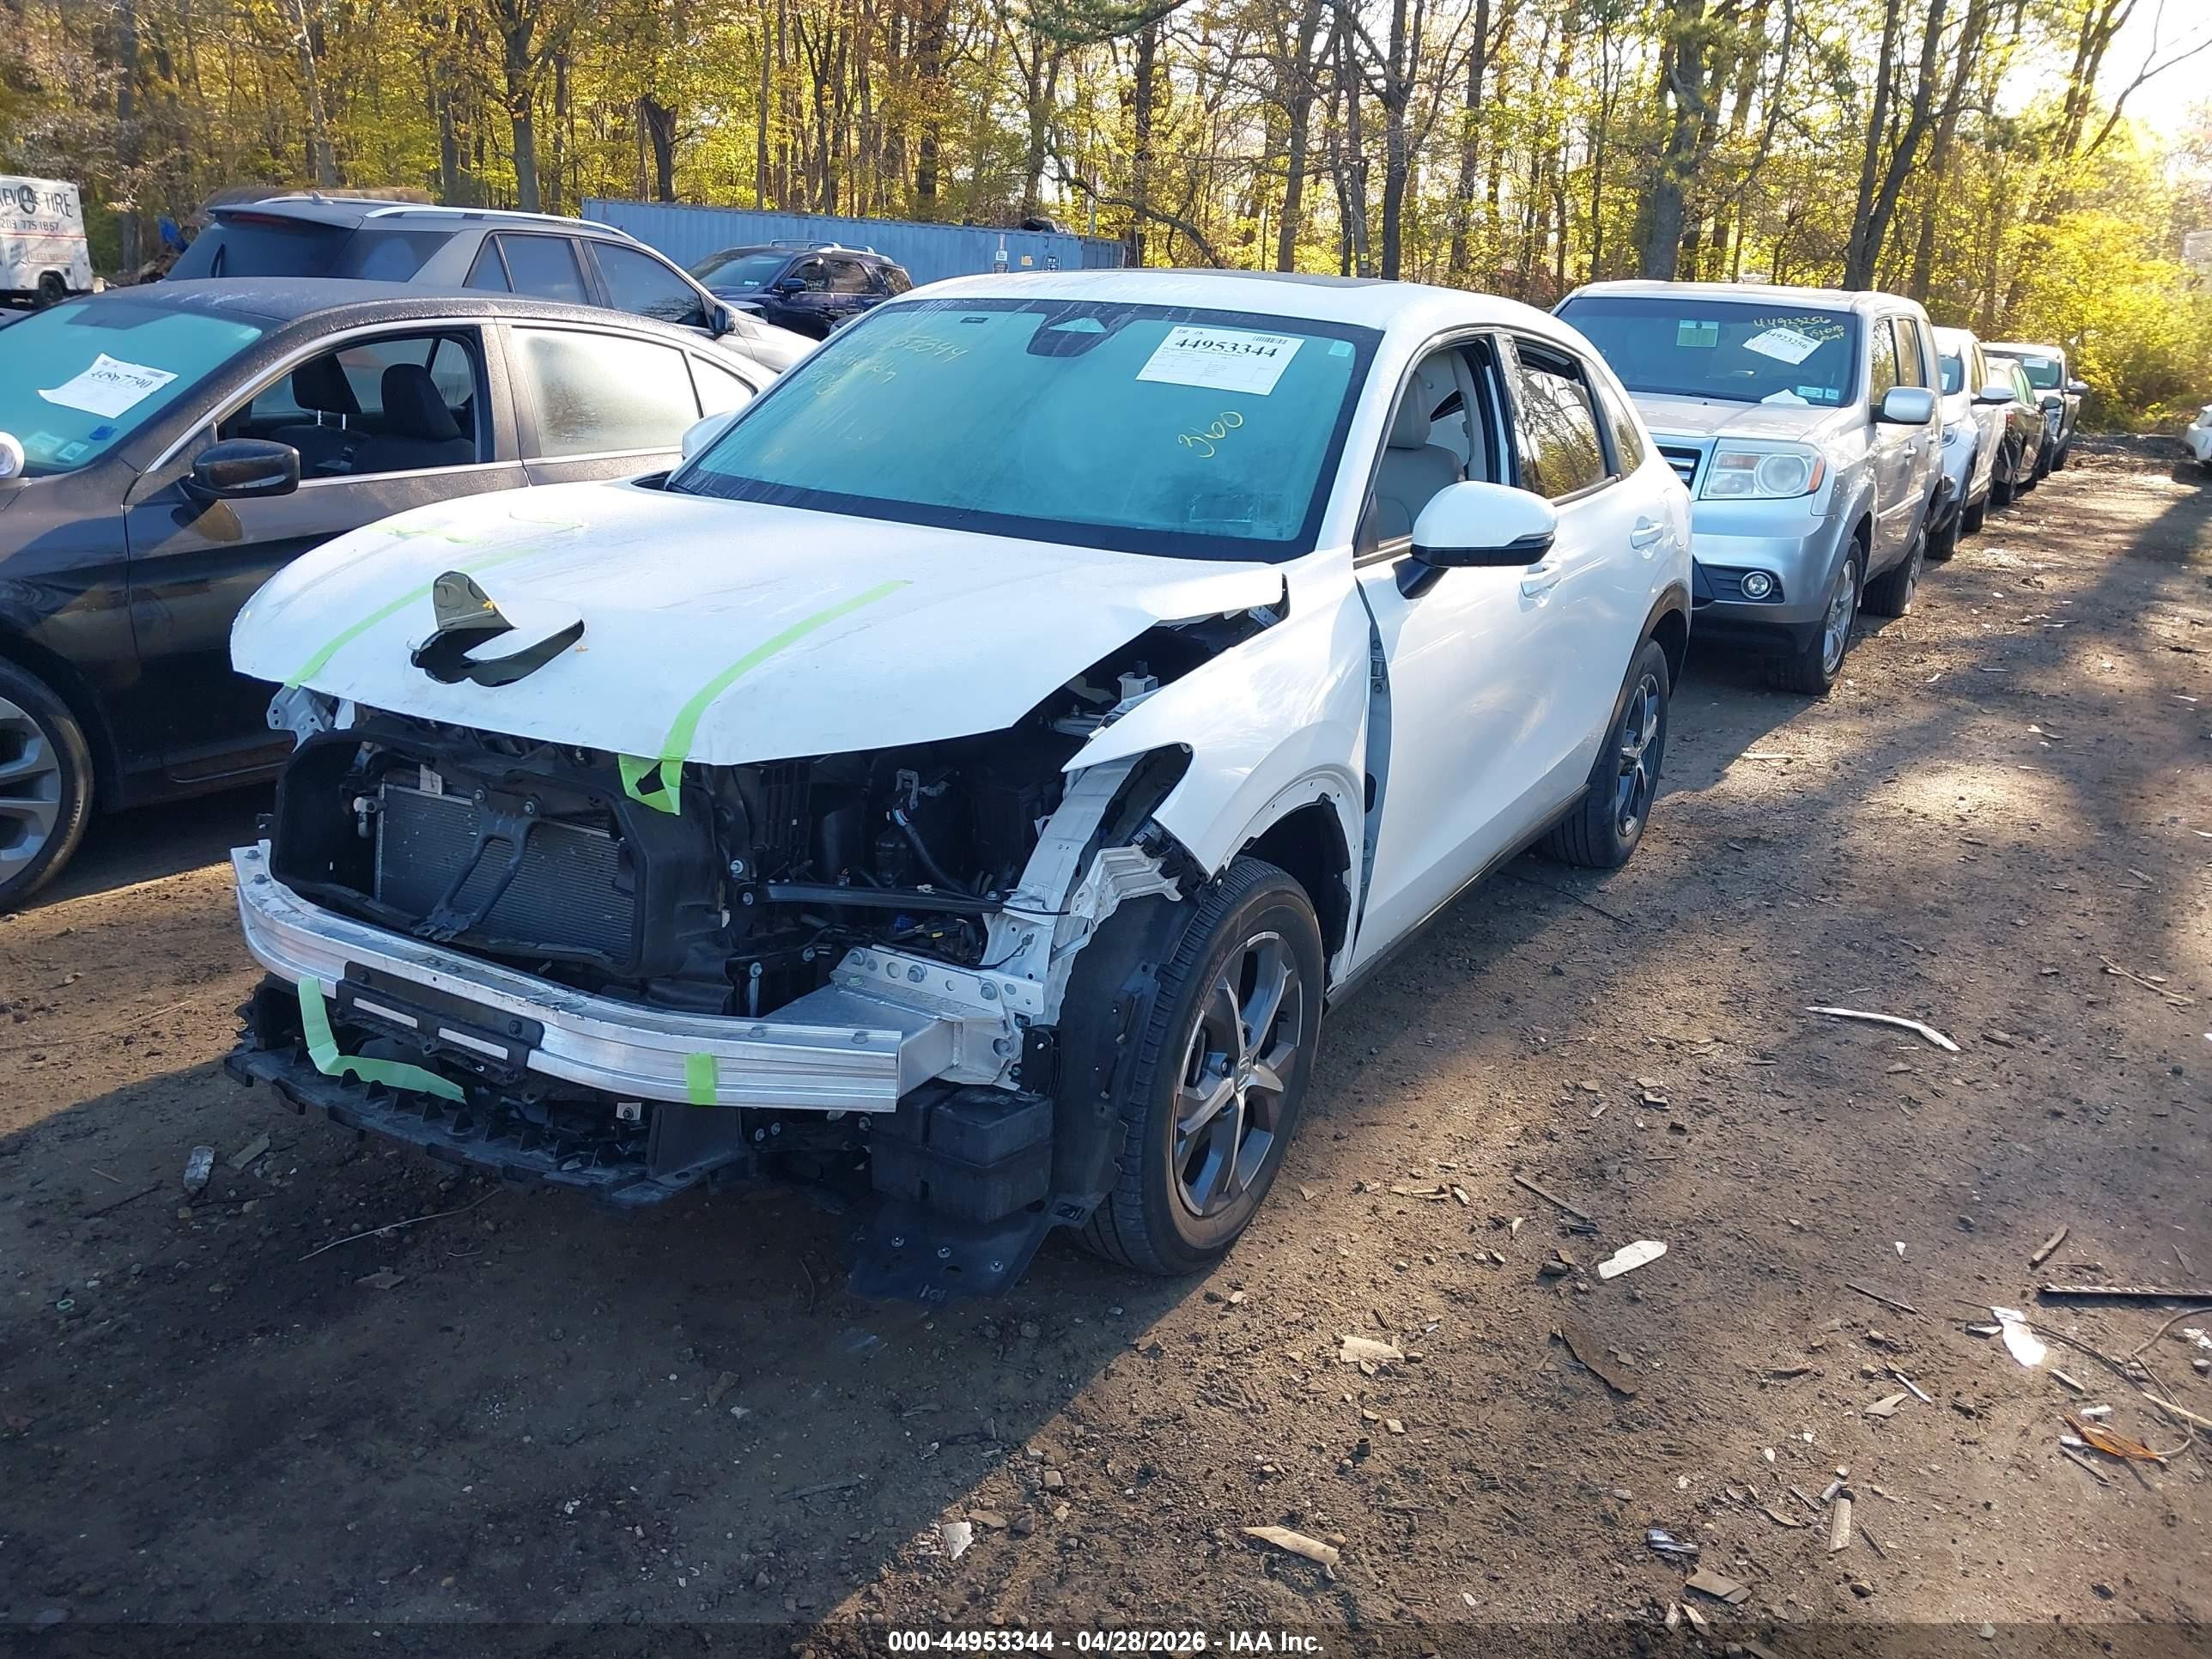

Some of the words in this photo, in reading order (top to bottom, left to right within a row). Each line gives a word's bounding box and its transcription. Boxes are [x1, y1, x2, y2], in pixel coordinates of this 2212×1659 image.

[43, 191, 73, 218] TIRE
[21, 220, 37, 230] 775
[1175, 337, 1279, 358] 44953344
[1177, 410, 1244, 458] 360
